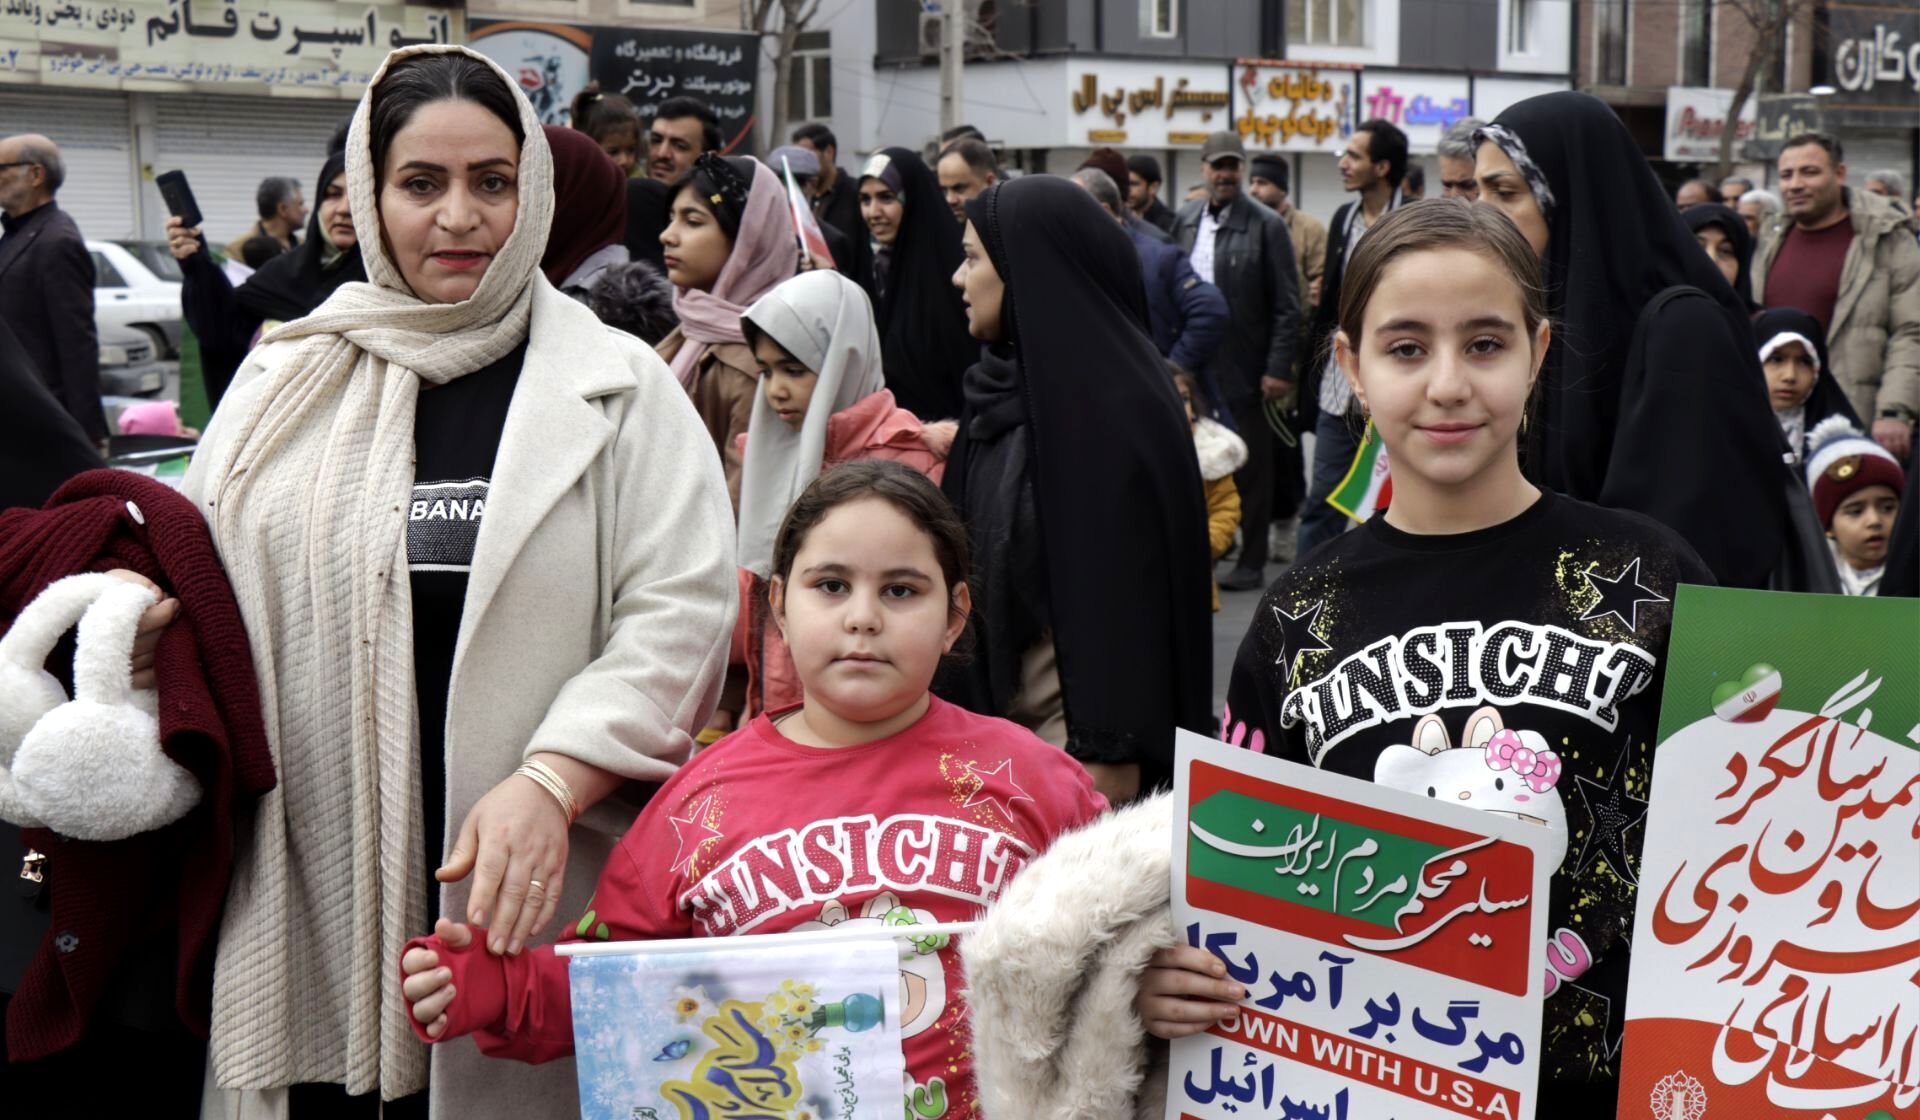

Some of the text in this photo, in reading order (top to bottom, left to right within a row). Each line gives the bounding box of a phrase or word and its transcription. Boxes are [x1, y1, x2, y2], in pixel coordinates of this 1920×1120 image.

[250, 10, 376, 58] اسپرت
[615, 40, 673, 61] تعمیرگاه
[684, 43, 742, 65] فروشگاه
[1189, 812, 1530, 952] سیلی محکم مردم ایران
[1186, 921, 1526, 1074] مرگ بر آمریکا
[1216, 1012, 1513, 1120] OWN WITH U.S.A
